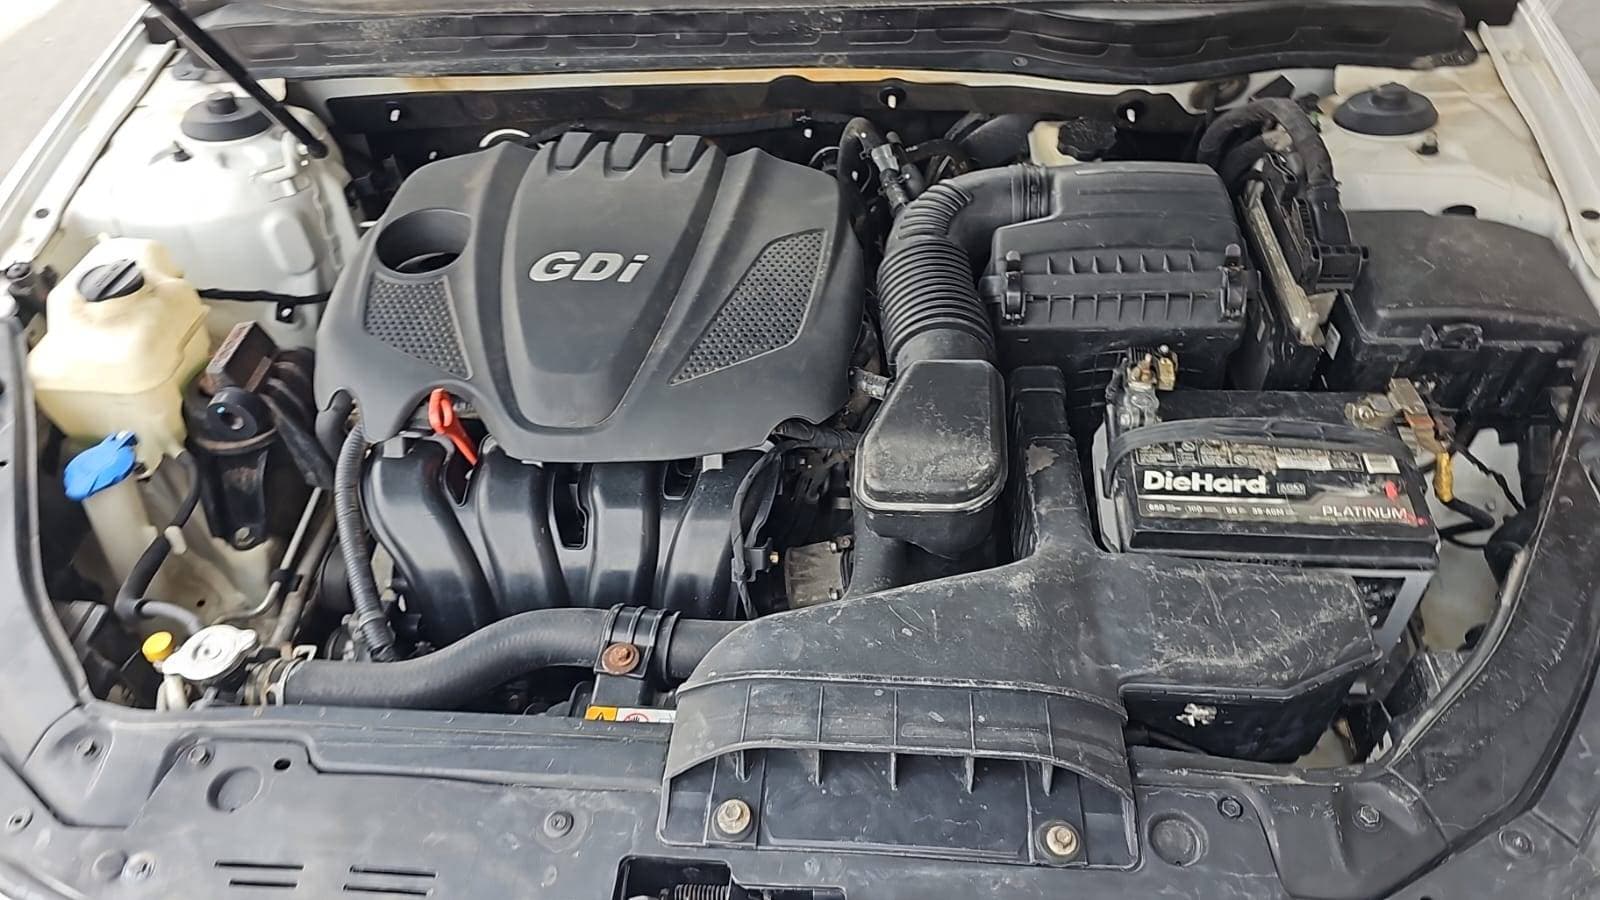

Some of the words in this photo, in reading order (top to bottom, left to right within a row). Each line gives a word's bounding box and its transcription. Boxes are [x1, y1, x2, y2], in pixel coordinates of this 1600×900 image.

[528, 251, 650, 282] GDi
[1143, 470, 1267, 494] DieHard
[1322, 505, 1407, 519] PLATINUM
